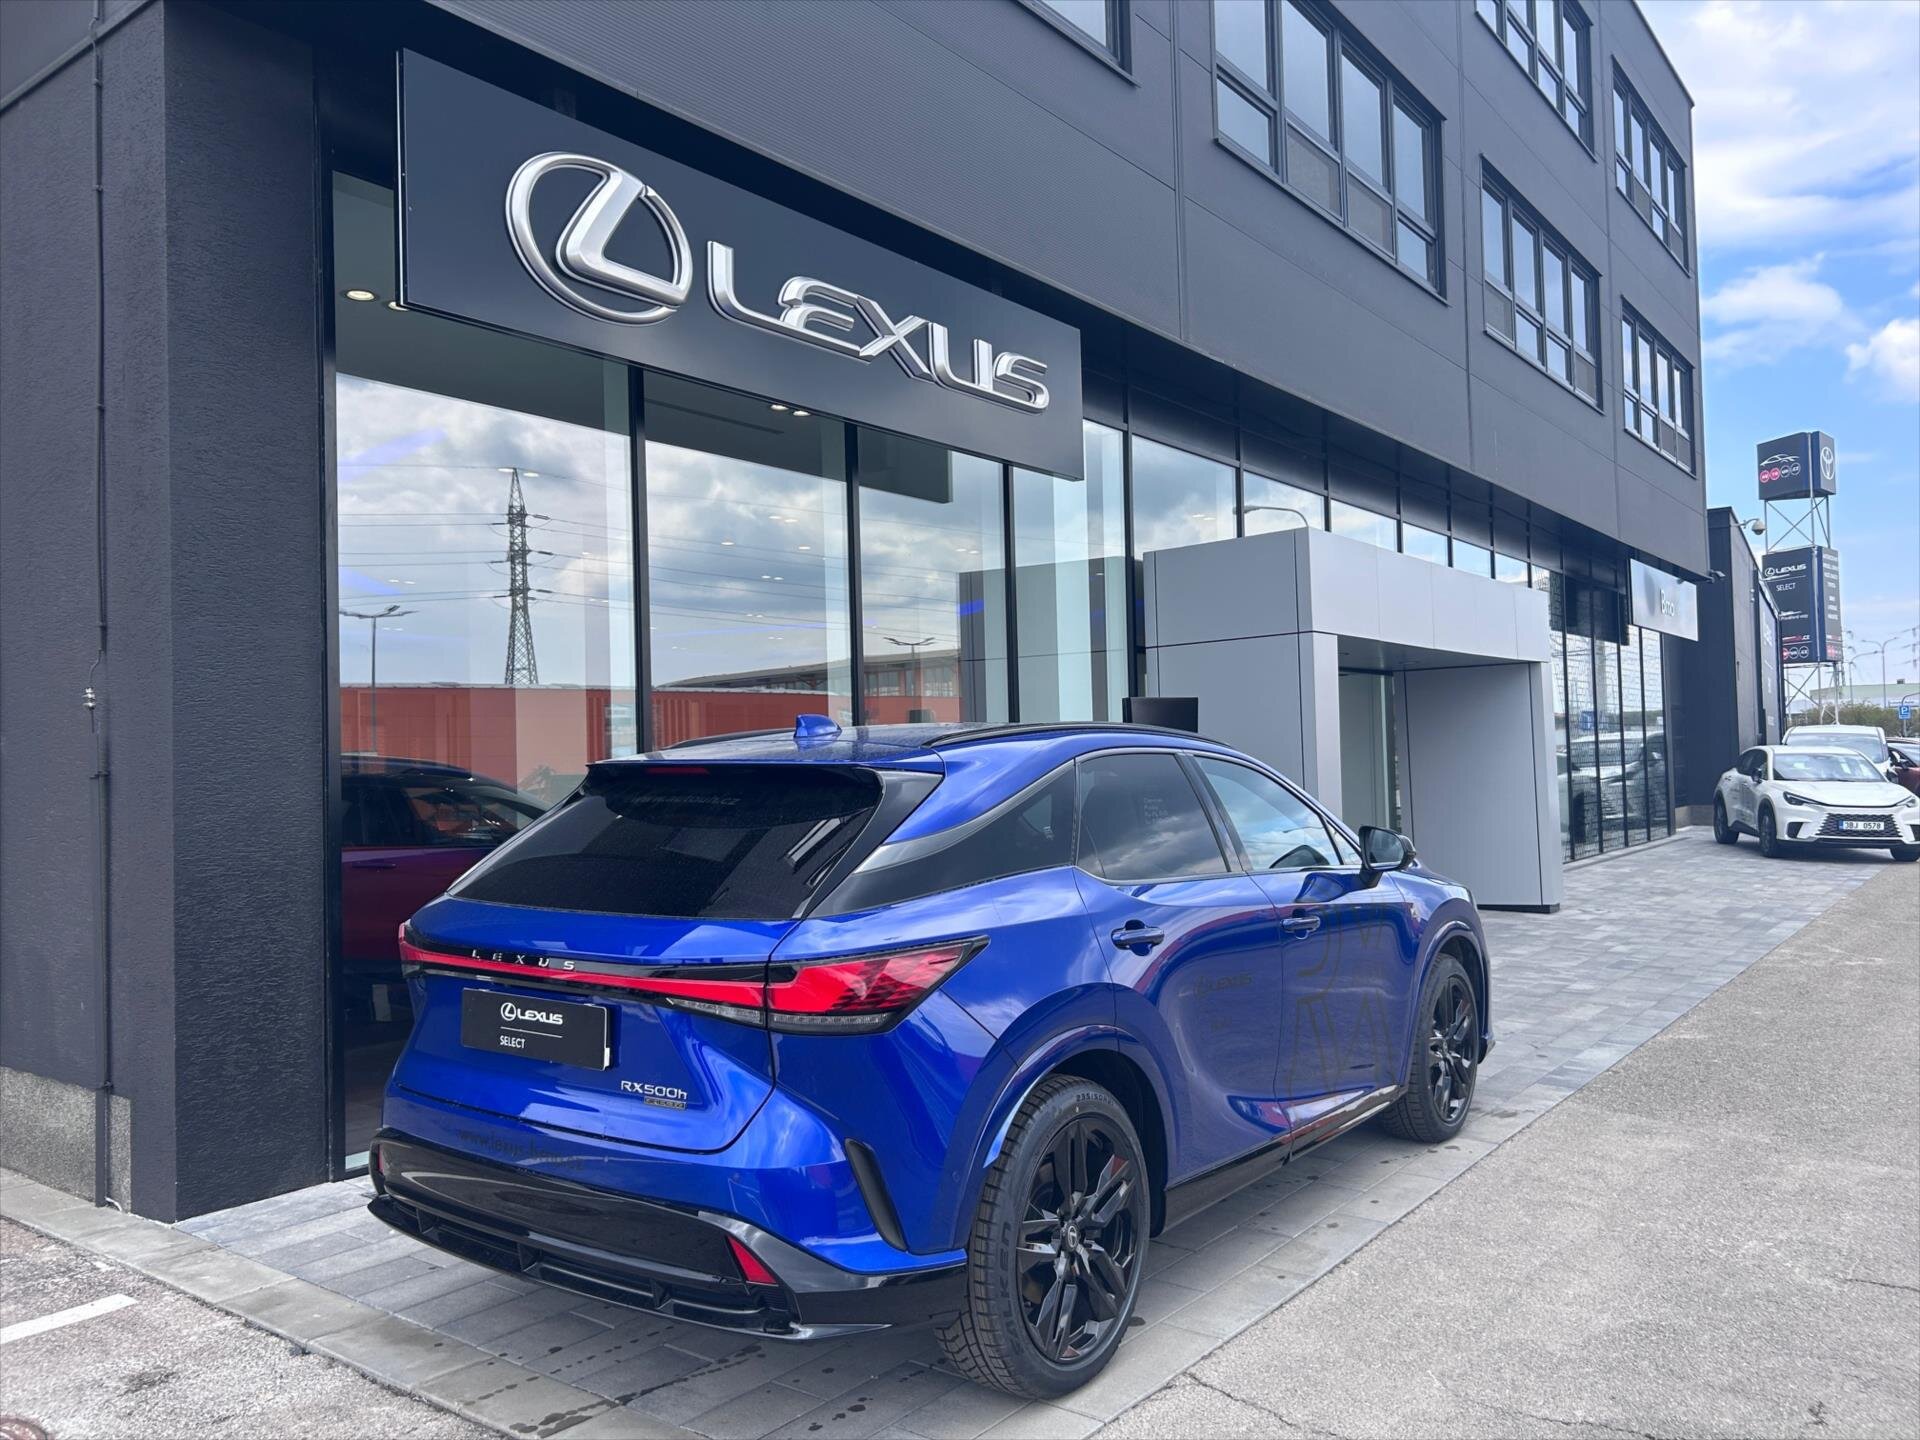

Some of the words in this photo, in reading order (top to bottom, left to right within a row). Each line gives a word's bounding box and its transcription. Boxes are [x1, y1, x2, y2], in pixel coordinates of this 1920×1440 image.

[707, 240, 1049, 413] LEXUS
[1776, 563, 1806, 574] LEXUS
[1776, 582, 1796, 592] SELECT
[471, 949, 575, 970] LEXUS
[517, 1008, 564, 1026] LEXUS
[499, 1035, 526, 1049] SELECT
[620, 1080, 688, 1100] RX500h
